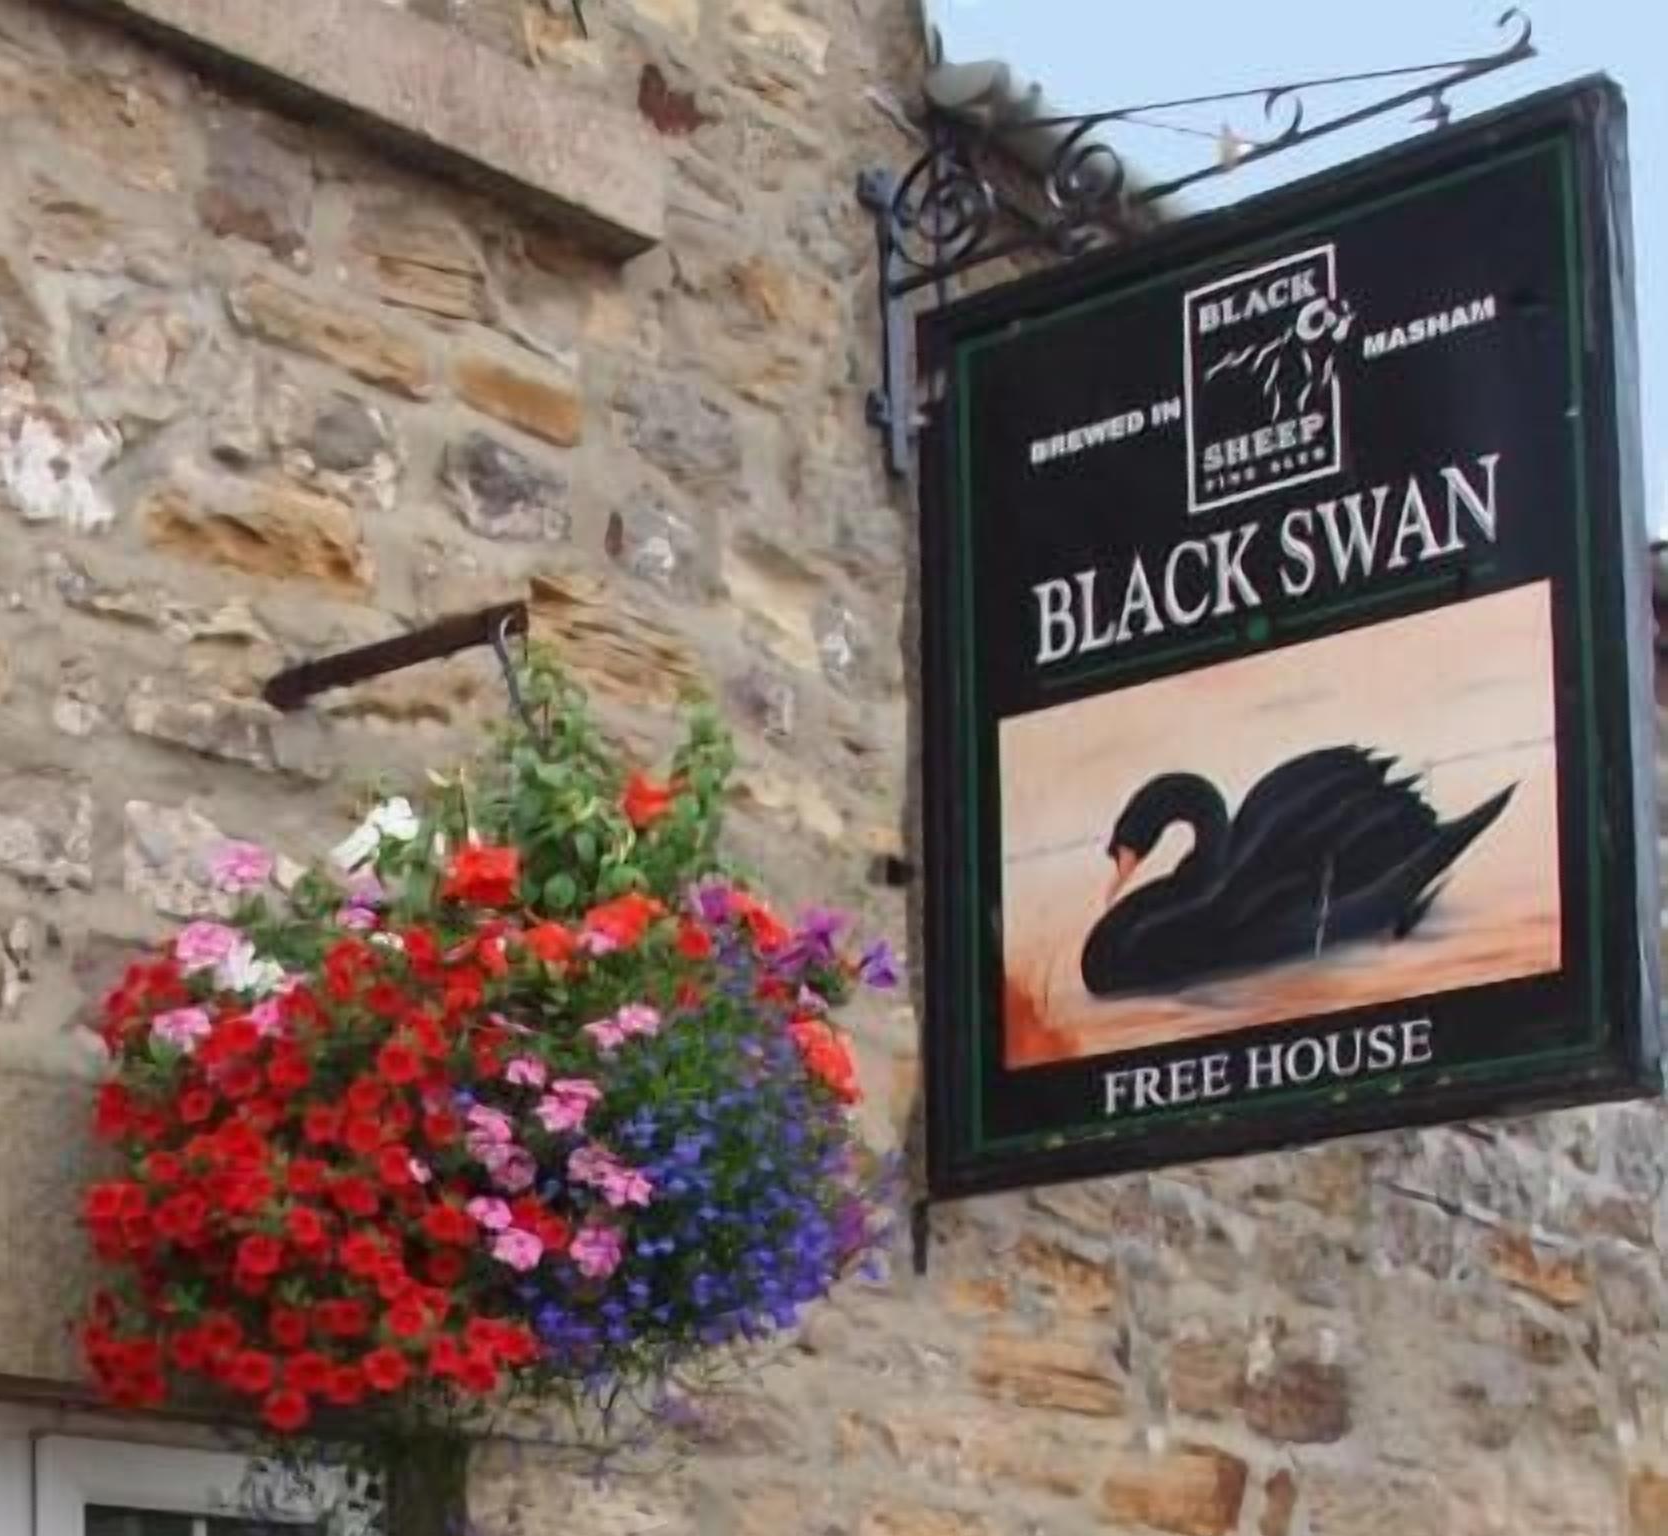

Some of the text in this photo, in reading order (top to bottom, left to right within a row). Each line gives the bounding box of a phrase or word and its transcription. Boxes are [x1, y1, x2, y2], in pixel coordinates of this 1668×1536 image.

[1199, 269, 1318, 334] BLACK
[1363, 296, 1497, 360] MASHAM
[1030, 396, 1182, 465] BREWED IN
[1202, 411, 1326, 473] SHEEP
[1032, 453, 1501, 666] BLACK SWAN
[1102, 1018, 1433, 1117] FREE HOUSE
